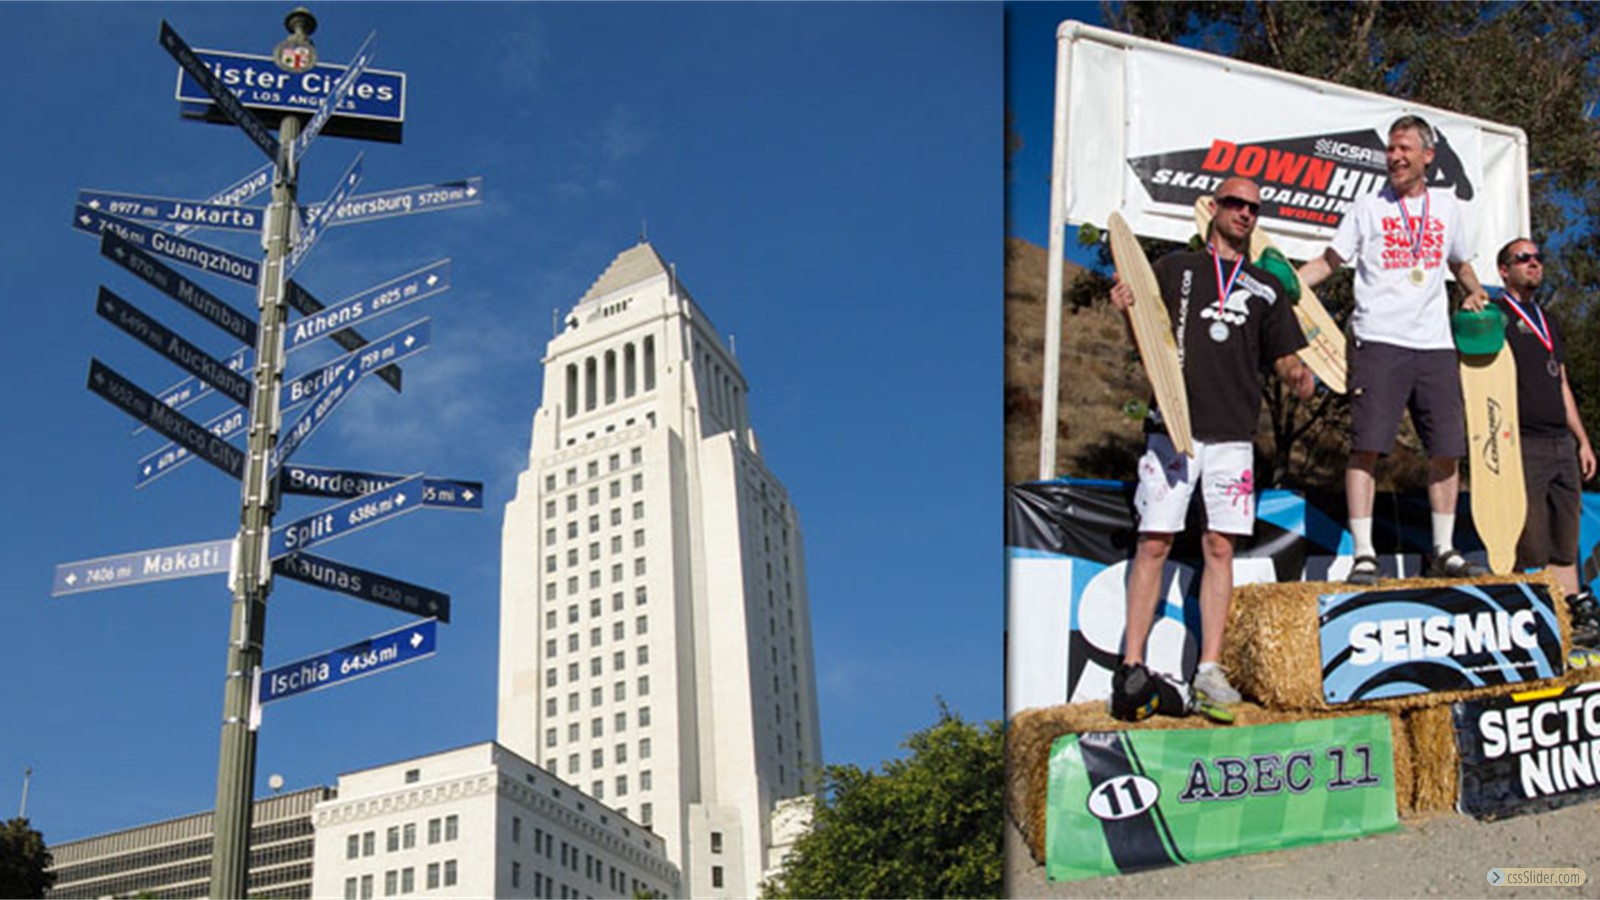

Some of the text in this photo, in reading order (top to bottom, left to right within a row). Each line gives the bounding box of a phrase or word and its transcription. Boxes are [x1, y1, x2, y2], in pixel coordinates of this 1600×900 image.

[204, 61, 290, 88] ister
[253, 91, 281, 102] LOS
[288, 95, 356, 109] ANGES
[1201, 138, 1388, 200] DOWNHI
[336, 195, 412, 219] etersburg
[1151, 168, 1348, 214] SKATOARDIN
[168, 204, 254, 226] Jakarta
[1279, 206, 1340, 225] WORLD
[152, 233, 253, 279] Guangzhou
[178, 279, 247, 337] Mumbai
[293, 302, 363, 343] Athens
[168, 336, 246, 399] Auckland
[151, 401, 206, 448] Mexico
[209, 438, 240, 472] City
[438, 489, 455, 500] mi
[285, 513, 333, 549] Split
[143, 547, 219, 574] Makati
[284, 554, 362, 591] Kaunas
[1348, 609, 1538, 666] SEISMIC
[271, 643, 397, 695] Ischia 6436 mi
[1180, 746, 1380, 803] ABEC 11
[1100, 777, 1145, 816] 11
